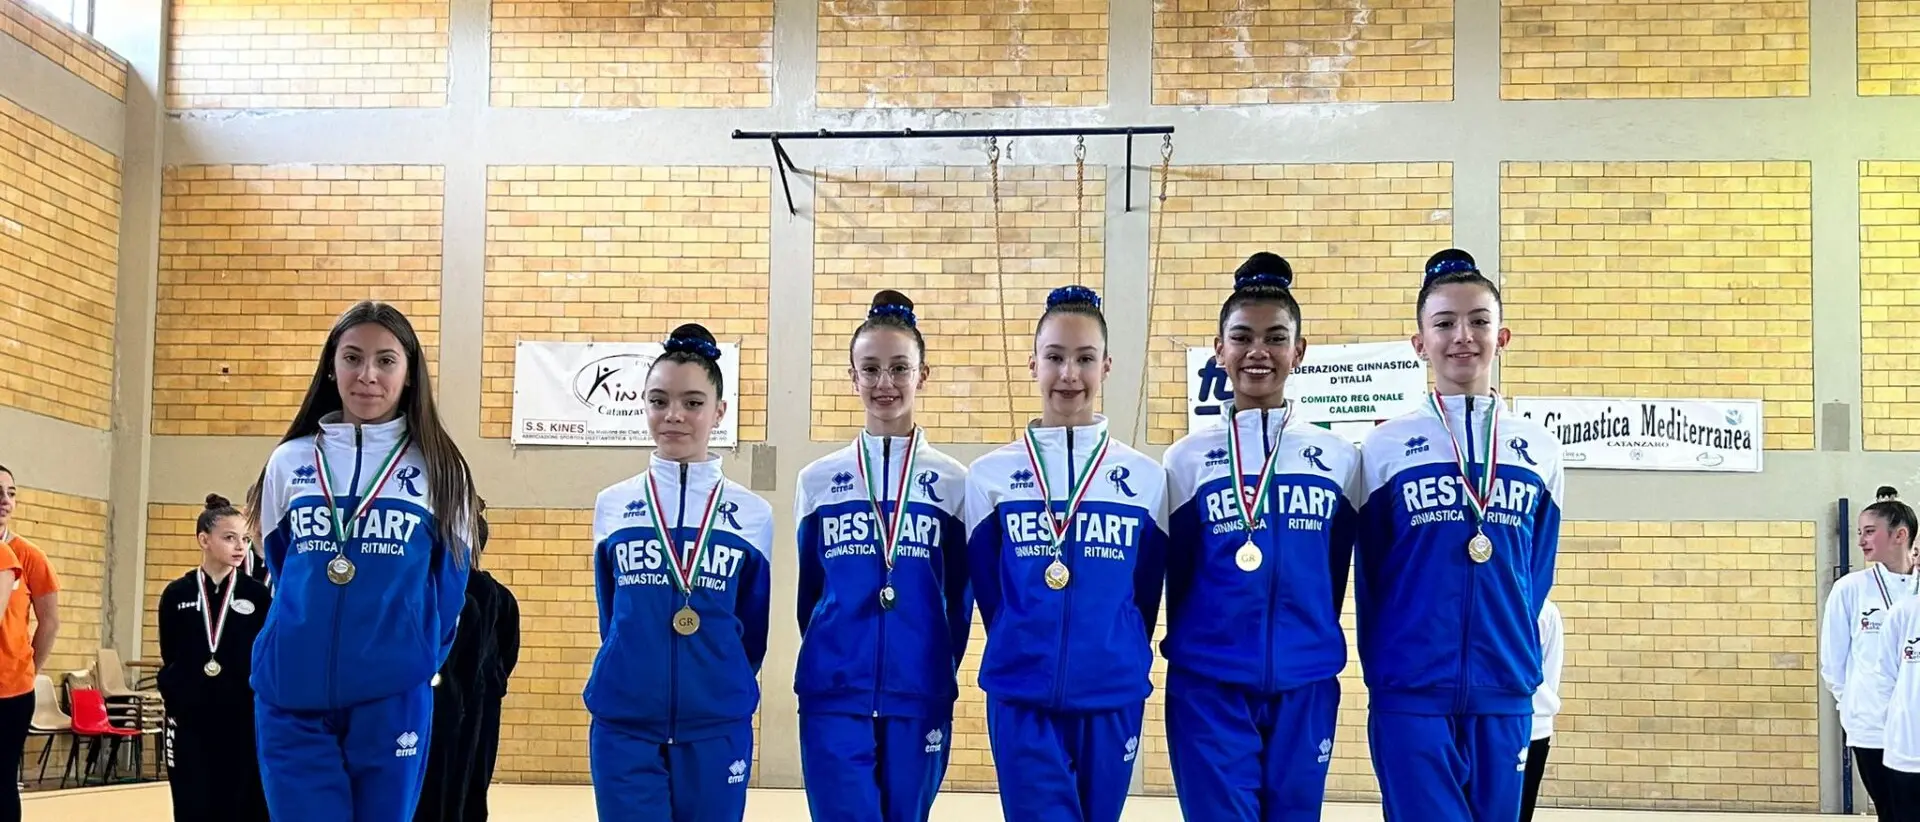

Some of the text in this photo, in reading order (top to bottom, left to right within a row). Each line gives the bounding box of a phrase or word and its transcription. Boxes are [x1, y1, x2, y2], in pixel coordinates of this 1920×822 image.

[1289, 360, 1420, 375] DERAZIONE GINNASTICA
[1330, 374, 1372, 385] D'ITALIA
[1301, 395, 1347, 404] COMITATO
[598, 405, 645, 416] Catanzar
[1329, 405, 1376, 414] CALABRIA
[526, 421, 546, 432] S.S.
[550, 423, 584, 434] KINES
[1641, 403, 1752, 450] Mediterranea
[1402, 475, 1538, 514] RESTART
[822, 511, 941, 547] RESTART
[1006, 511, 1139, 547] RESTART
[361, 542, 404, 556] RITMICA
[1084, 546, 1124, 560] RITMICA
[678, 618, 694, 627] GR
[166, 728, 175, 768] Zeus
